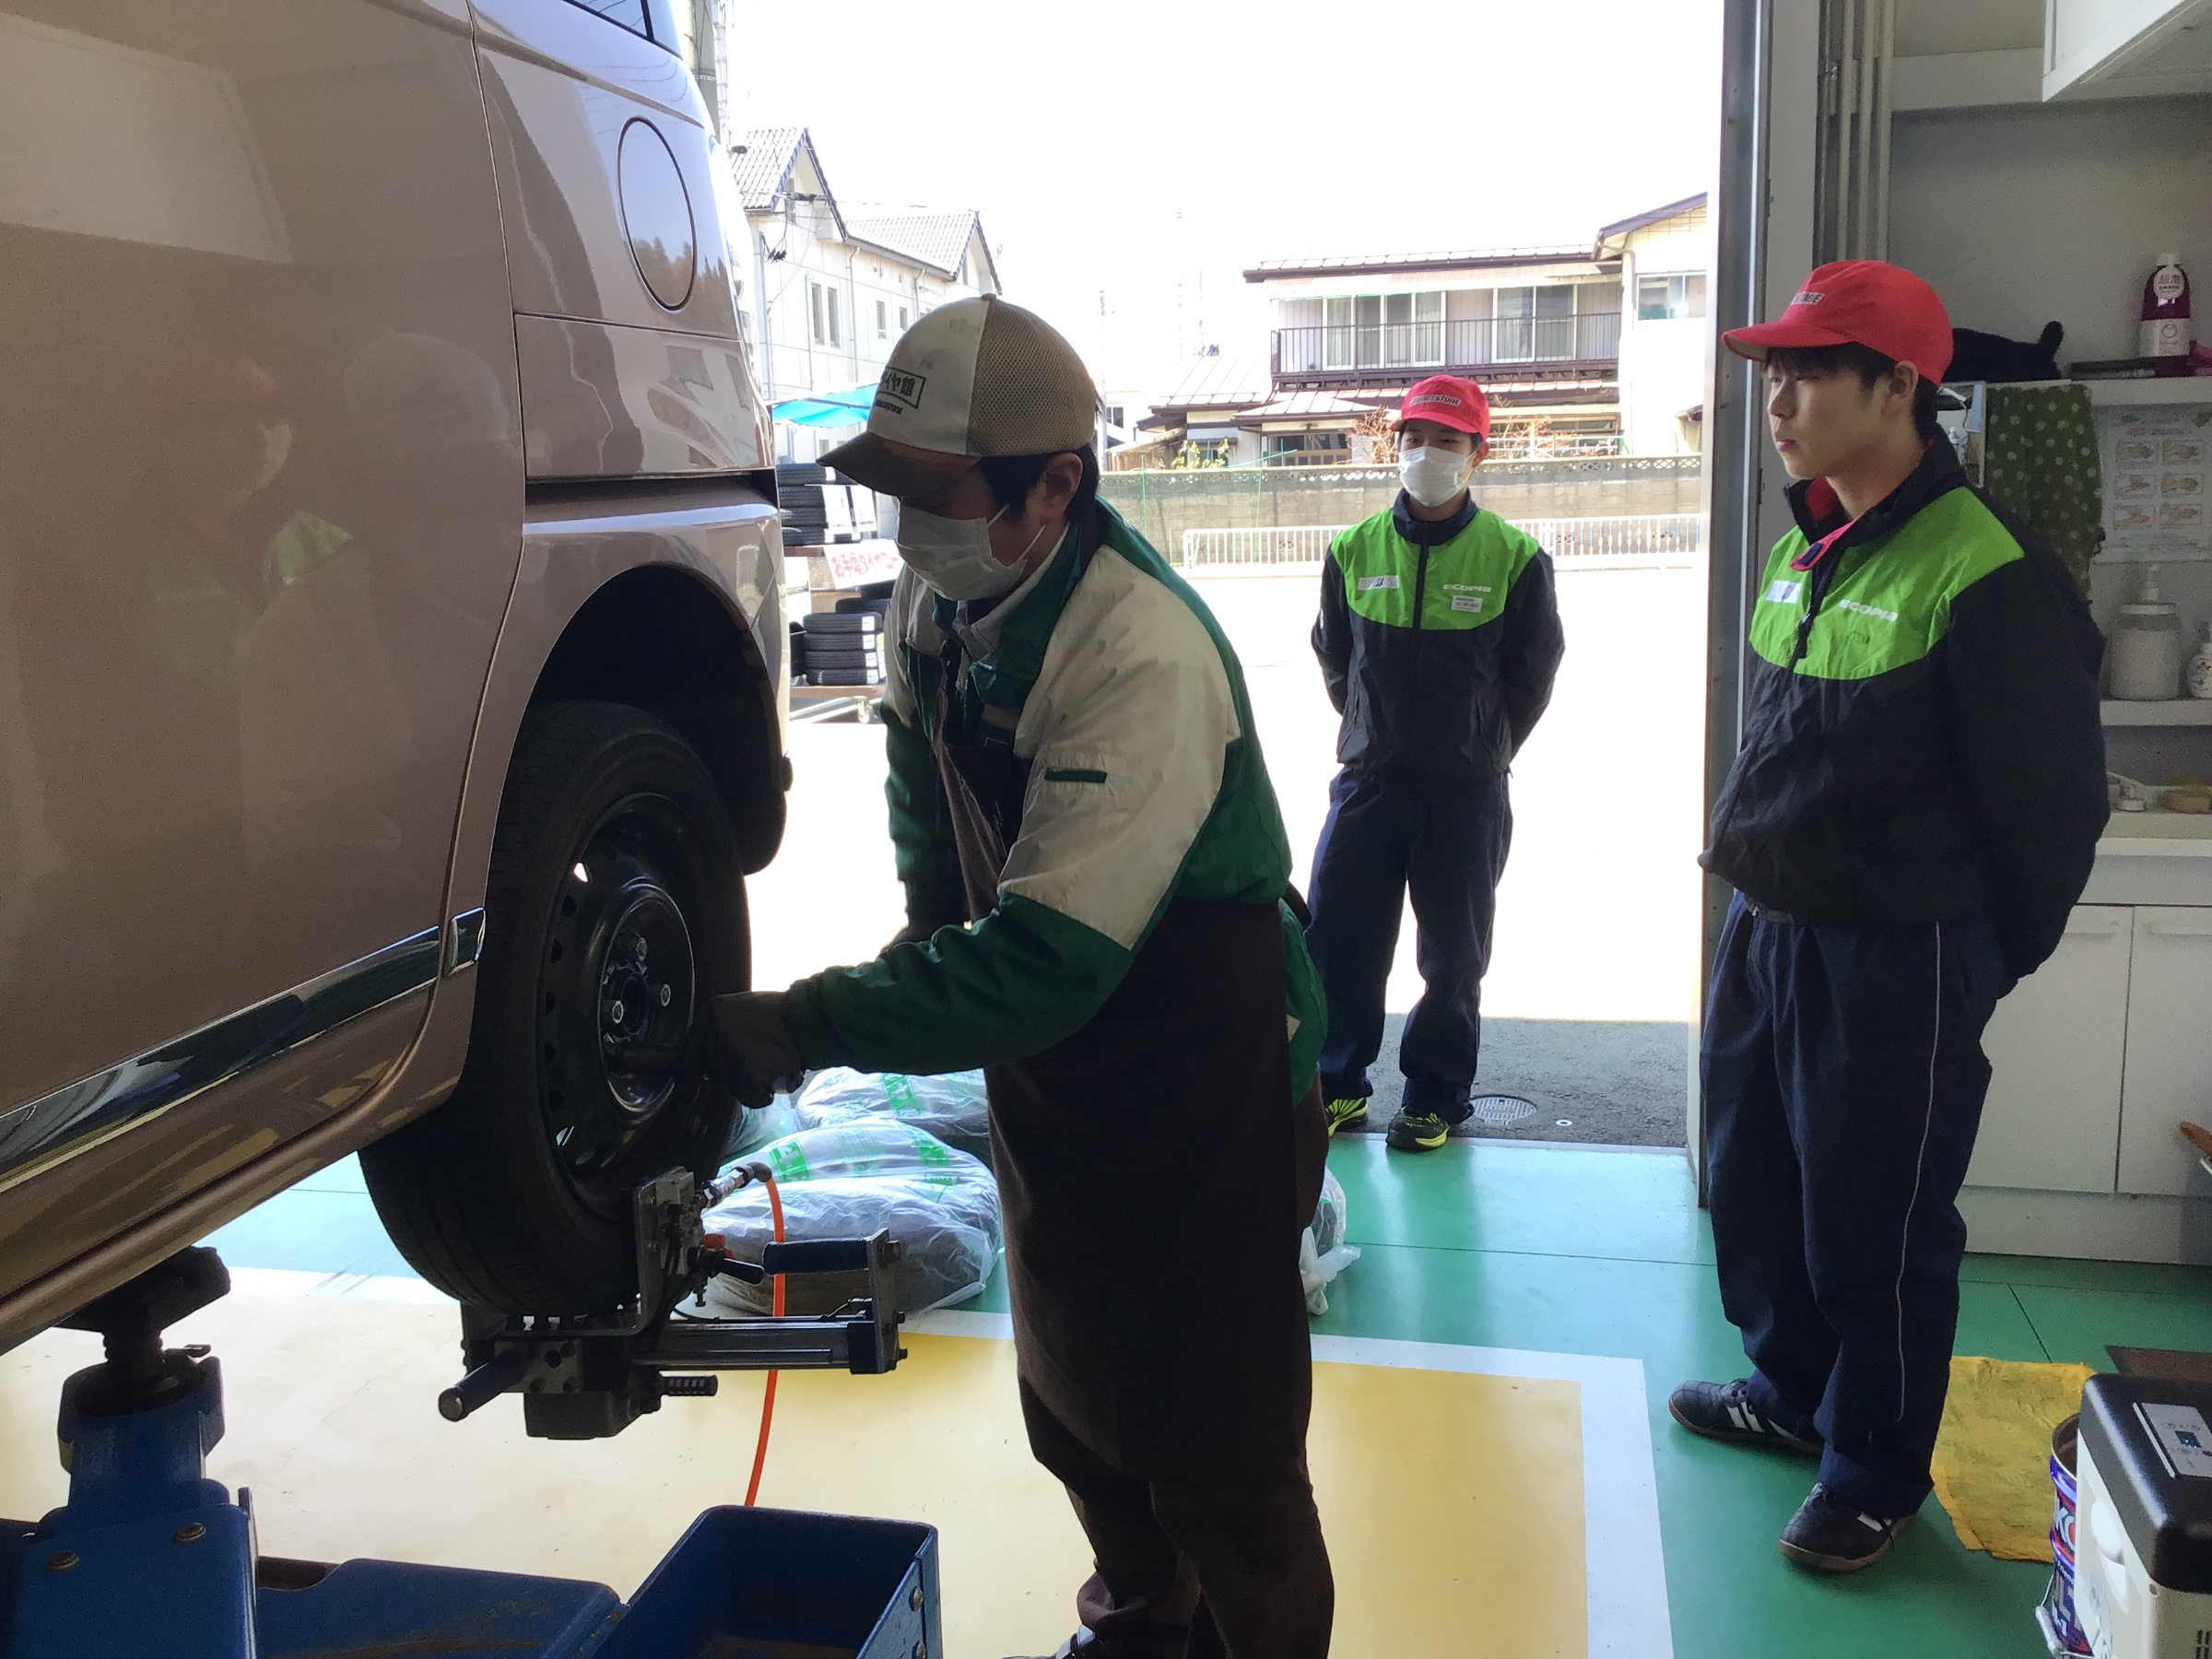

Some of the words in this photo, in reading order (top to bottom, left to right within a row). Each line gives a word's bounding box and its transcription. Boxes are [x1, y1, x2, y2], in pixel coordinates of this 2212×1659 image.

[831, 551, 900, 579] お手頃タイヤコー
